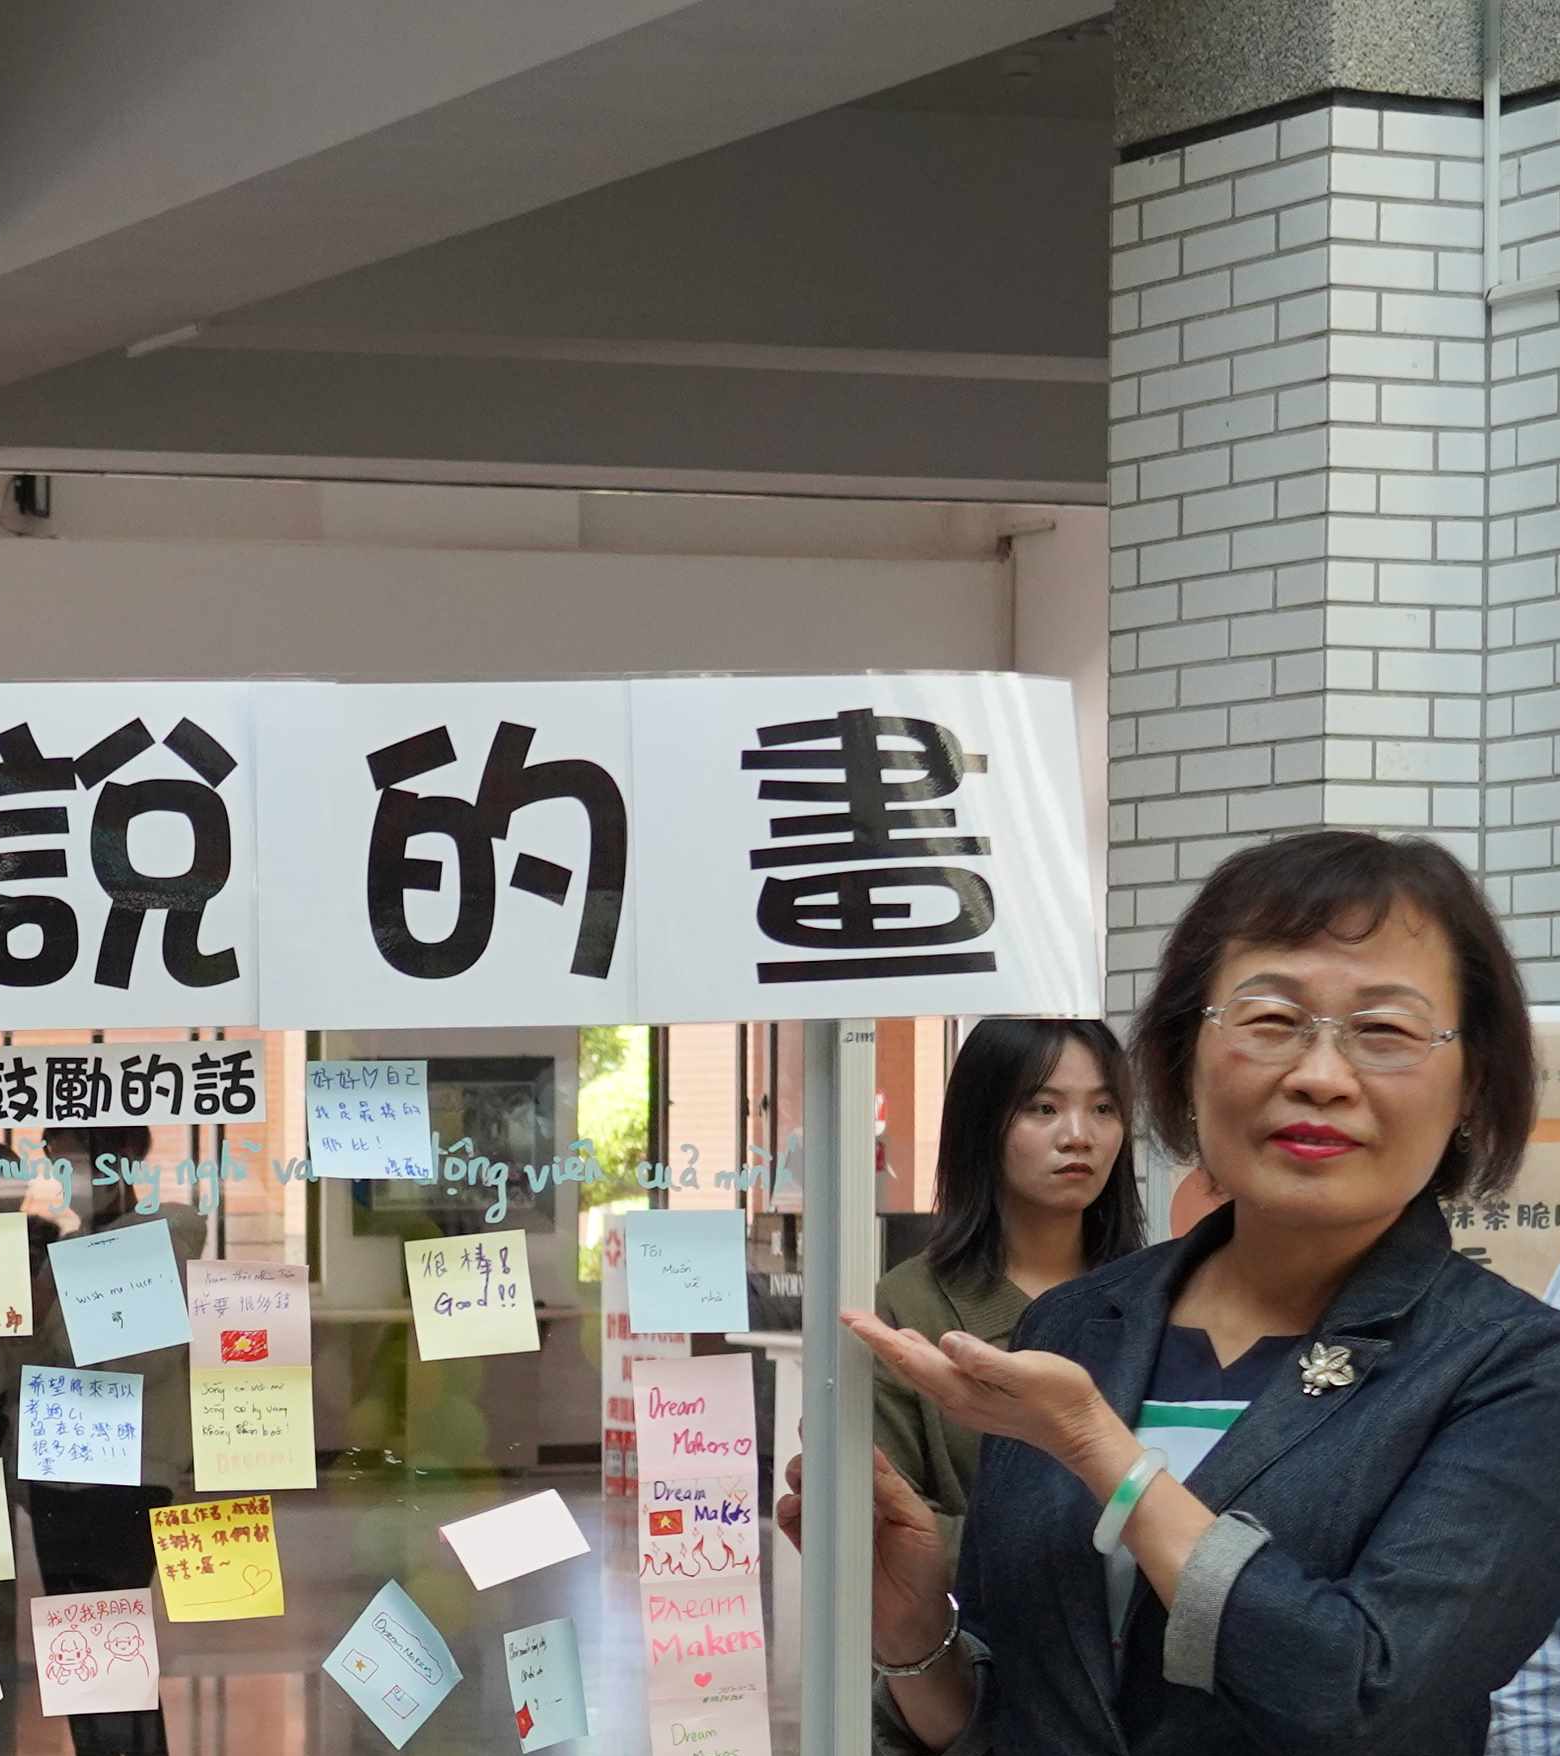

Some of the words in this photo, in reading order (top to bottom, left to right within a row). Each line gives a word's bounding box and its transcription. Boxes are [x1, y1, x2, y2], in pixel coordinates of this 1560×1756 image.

[648, 1386, 705, 1419] Dream
[653, 1479, 707, 1501] Dream
[647, 1593, 746, 1624] Dream
[650, 1624, 762, 1664] Makers
[669, 1722, 719, 1747] Dream
